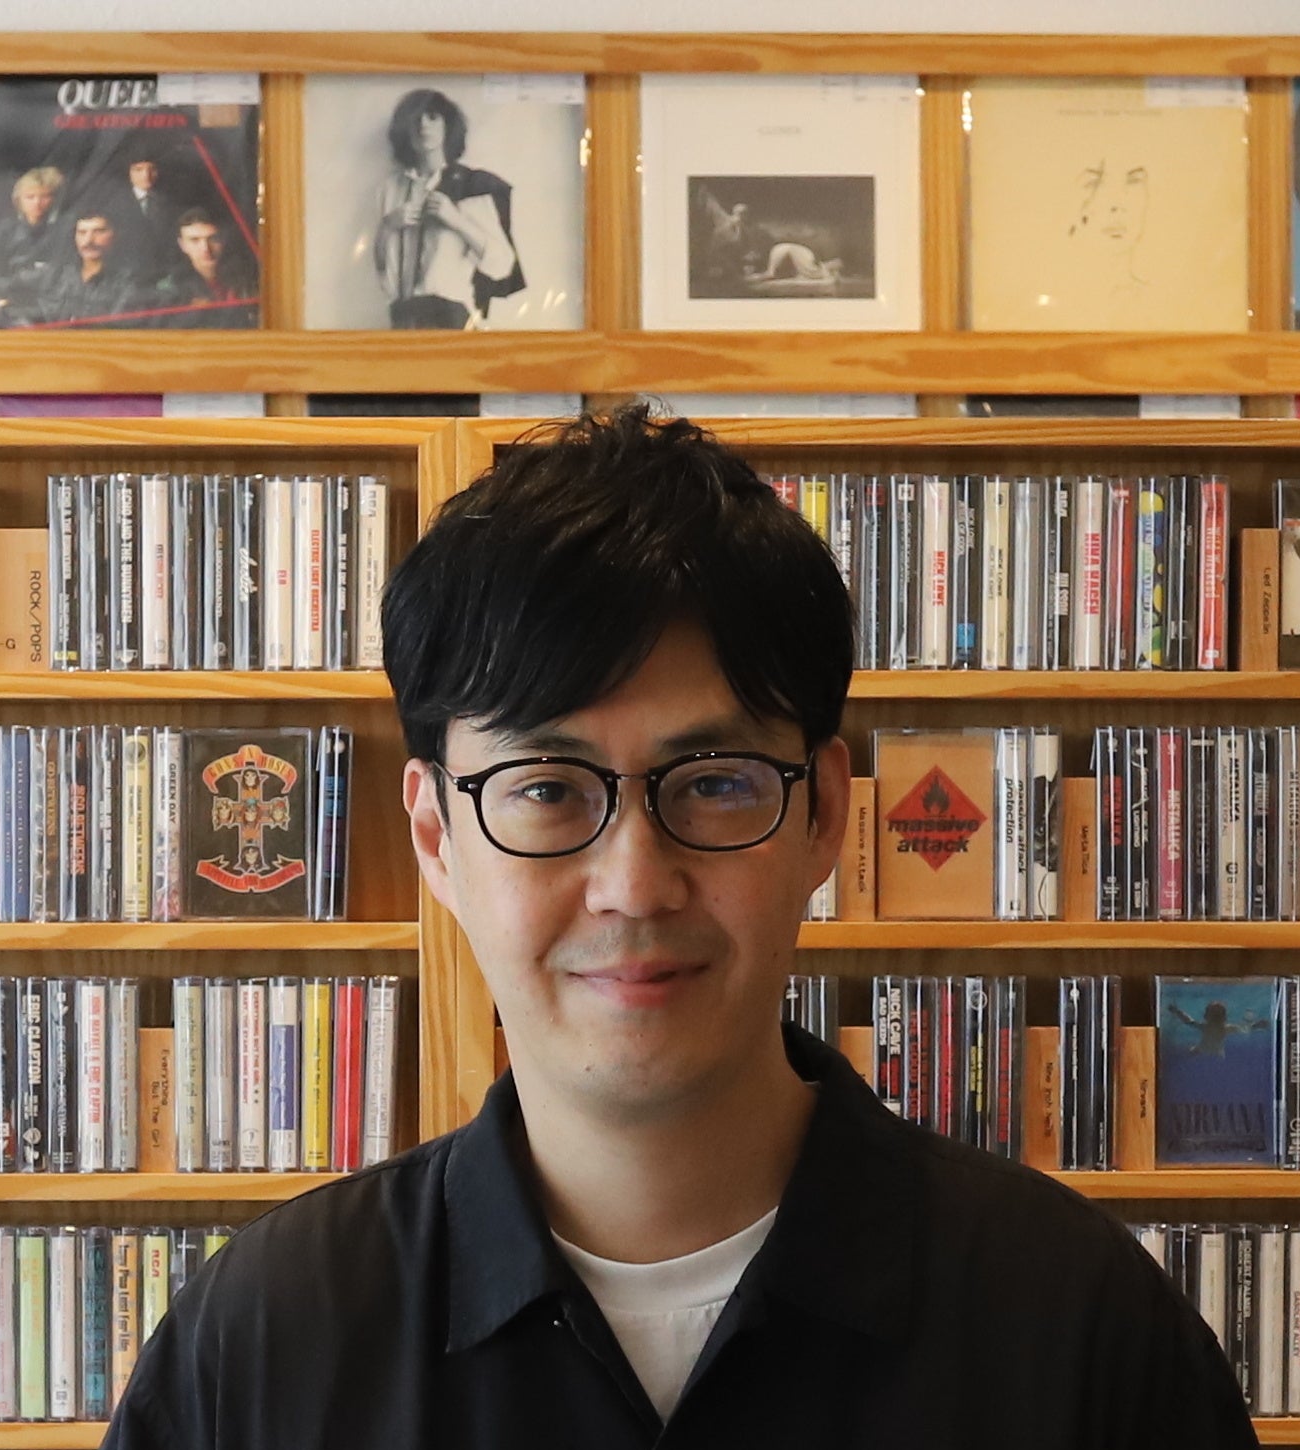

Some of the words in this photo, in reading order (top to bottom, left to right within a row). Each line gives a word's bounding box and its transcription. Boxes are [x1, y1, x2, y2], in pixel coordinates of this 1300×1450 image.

[57, 79, 158, 113] QUEE
[311, 530, 320, 563] ELECTRIC
[1085, 533, 1099, 565] NINA
[239, 547, 257, 602] elastica
[311, 565, 320, 588] LIGHT
[1085, 571, 1099, 615] HAGEN
[30, 570, 42, 662] ROCK/POPS
[311, 590, 320, 632] ORCHESTRA
[1229, 758, 1239, 822] METALLICA
[887, 817, 979, 832] massive
[1005, 778, 1015, 843] protection
[897, 838, 968, 853] attack
[890, 988, 901, 1018] NICK
[890, 1022, 901, 1055] CAVE
[152, 1081, 160, 1099] But
[160, 1049, 170, 1105] Everything
[152, 1105, 160, 1126] The
[152, 1130, 160, 1148] Girl
